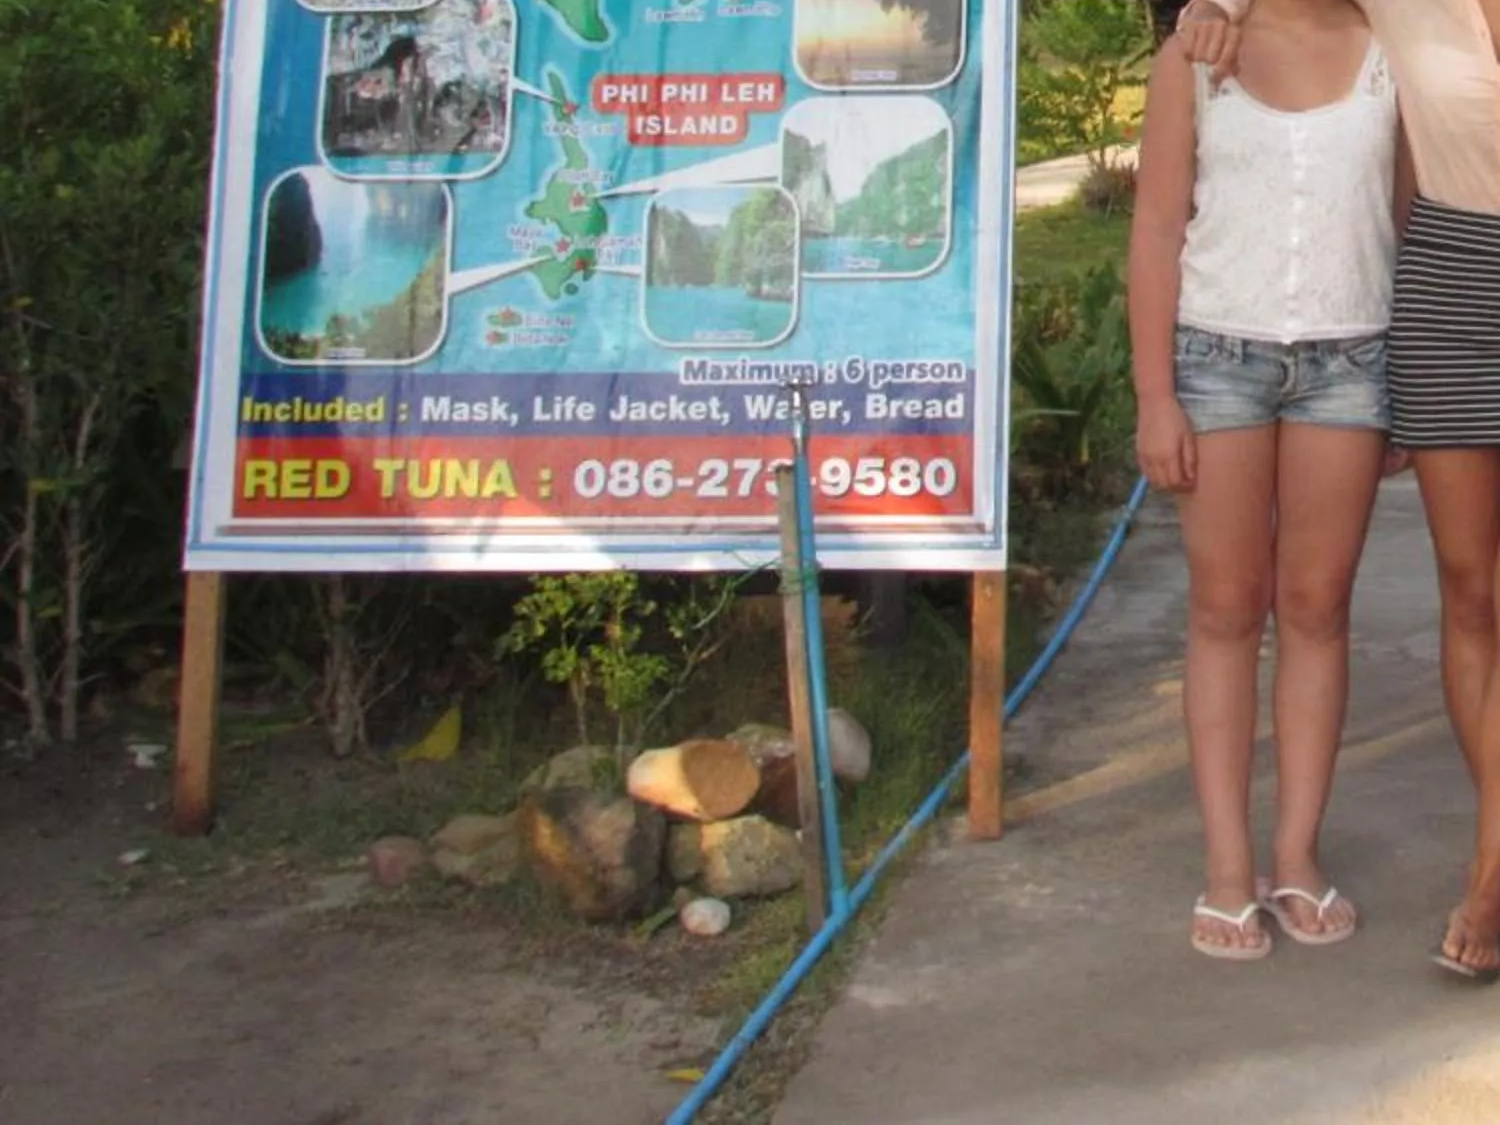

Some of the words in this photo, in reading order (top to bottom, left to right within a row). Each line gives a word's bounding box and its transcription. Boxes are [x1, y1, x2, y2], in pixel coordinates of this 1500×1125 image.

[602, 84, 648, 104] PHI
[661, 83, 707, 103] PHI
[721, 82, 776, 102] LEH
[636, 115, 738, 135] ISLAND
[684, 359, 815, 381] Maximum
[846, 359, 864, 382] 6
[872, 361, 964, 386] person
[242, 396, 385, 422] Included
[421, 396, 519, 427] Mask,
[533, 395, 595, 422] Life
[609, 394, 731, 425] Jacket,
[744, 395, 851, 424] Waer,
[865, 394, 964, 421] Bread
[243, 459, 351, 499] RED
[373, 459, 518, 499] TUNA
